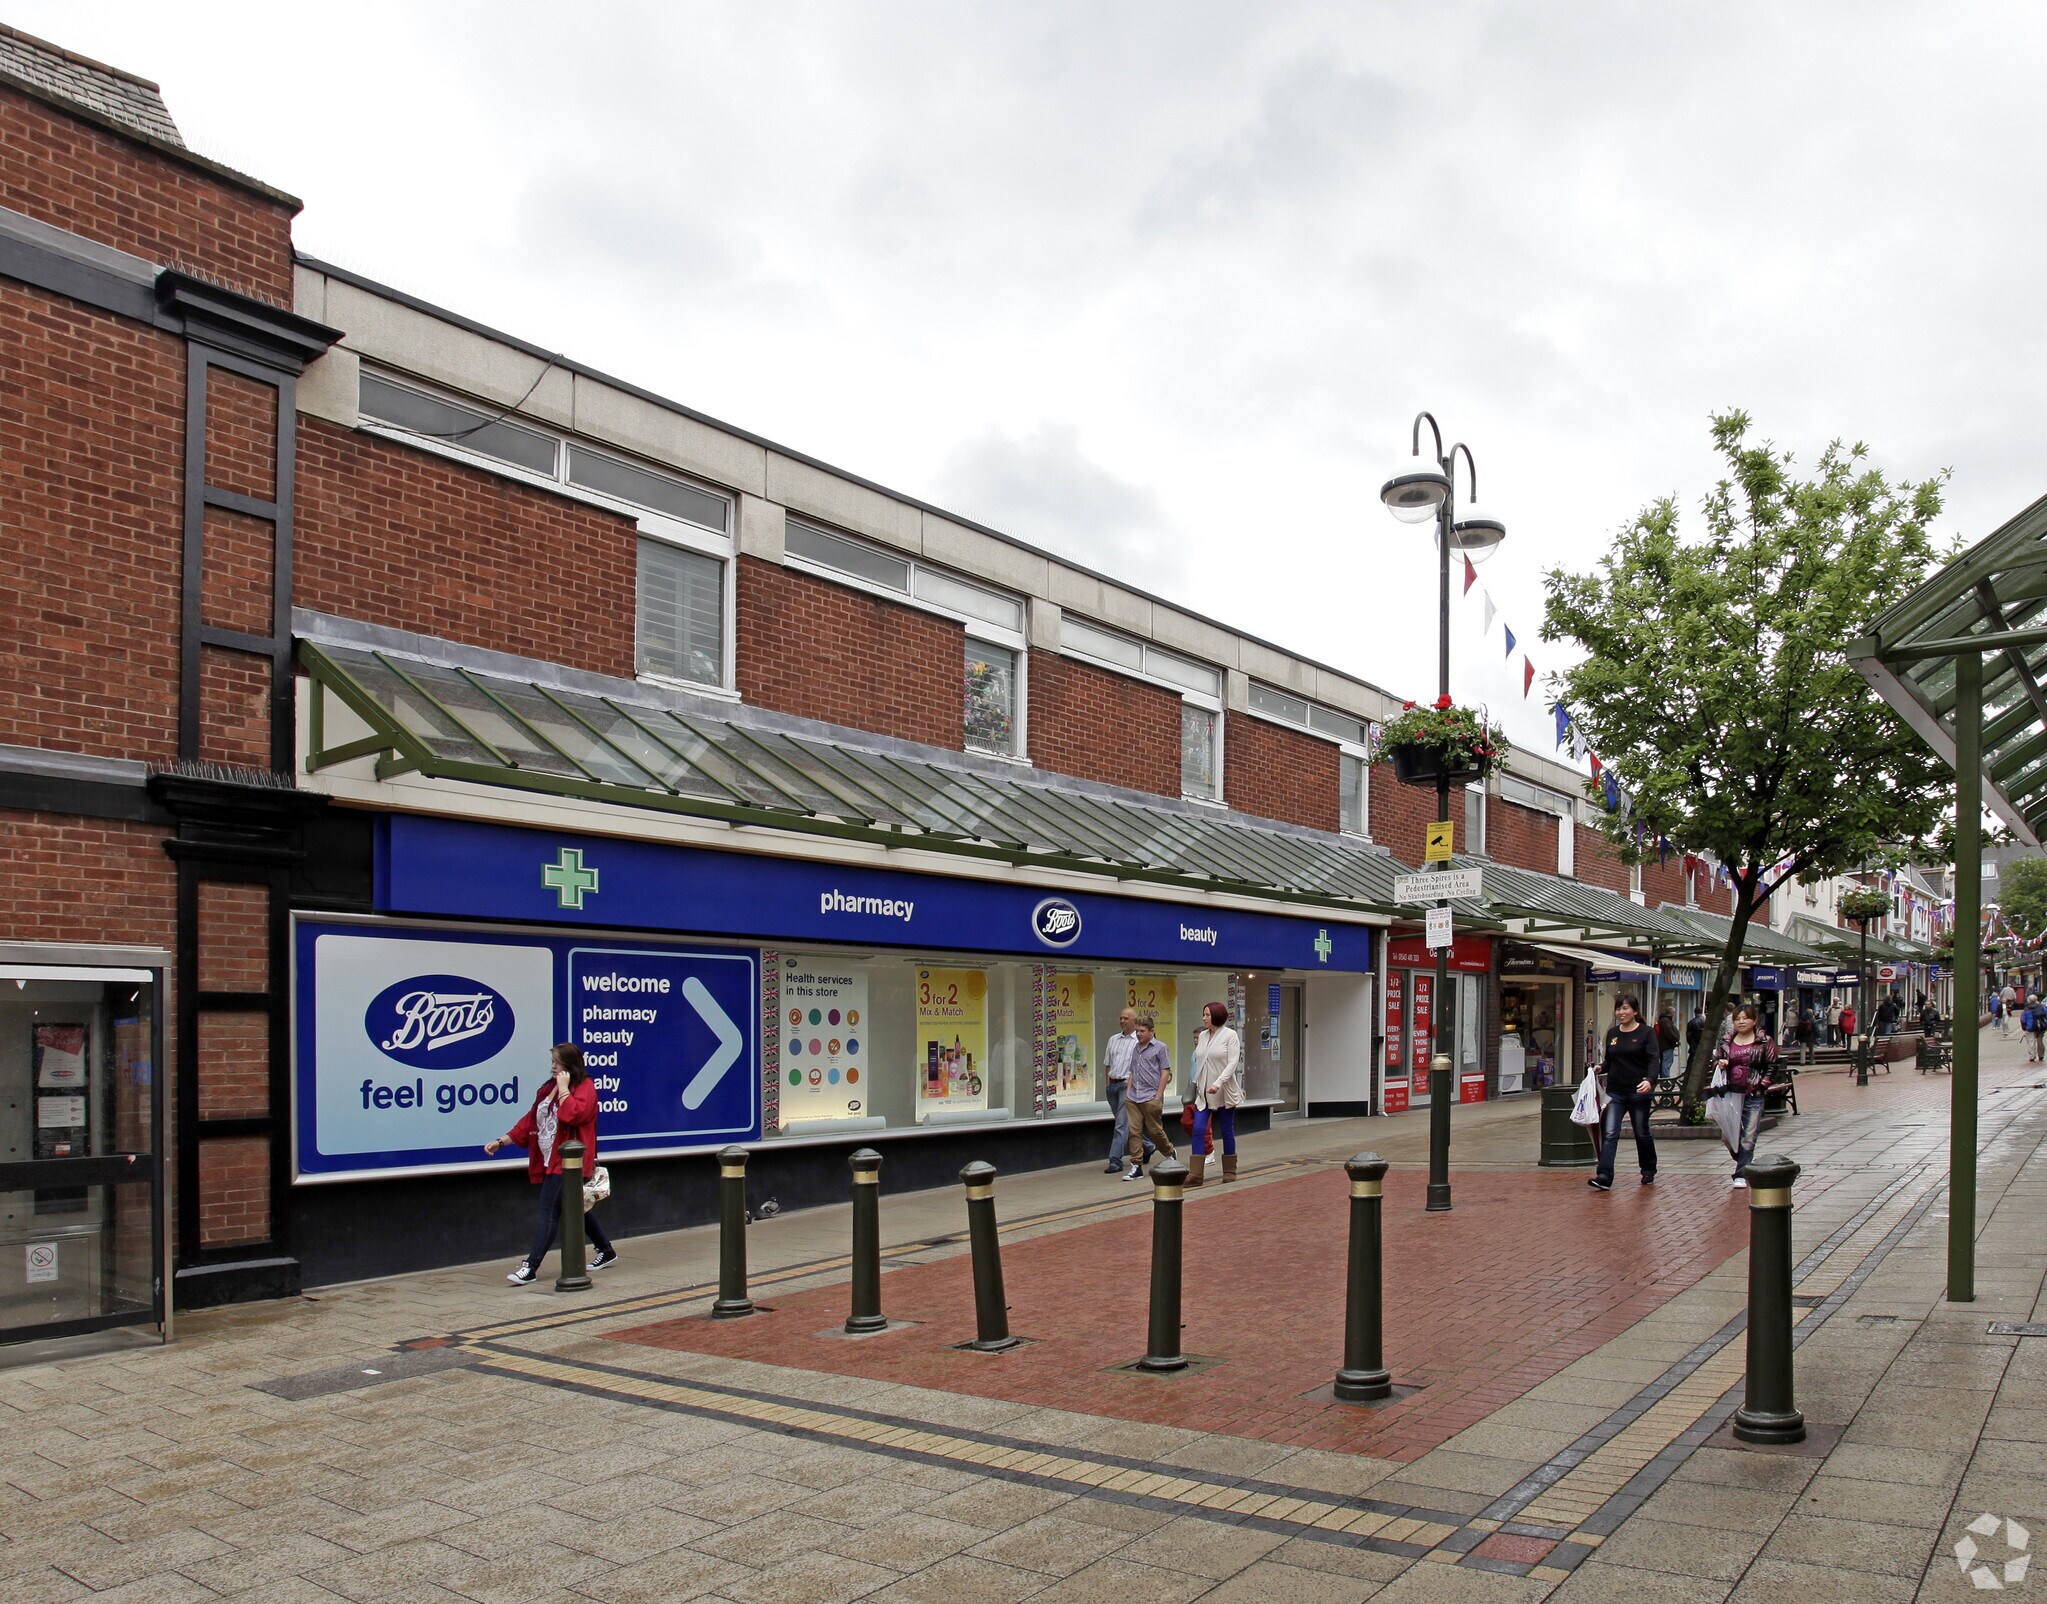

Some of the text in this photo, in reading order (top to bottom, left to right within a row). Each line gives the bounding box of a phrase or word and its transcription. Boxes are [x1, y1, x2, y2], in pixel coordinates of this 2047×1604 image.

[1431, 874, 1451, 882] Spires
[1406, 882, 1452, 892] Pedestrianised
[1408, 891, 1444, 900] Skateboarding
[821, 888, 914, 921] pharmacy
[1042, 908, 1075, 934] Boots
[1180, 923, 1217, 946] beauty
[582, 972, 670, 994] welcome
[786, 973, 853, 985] Health services
[1390, 978, 1399, 987] 1/2
[786, 986, 838, 996] in this store
[920, 983, 958, 1005] 3 for 2
[1387, 990, 1401, 998] PRICE
[1419, 984, 1427, 992] 1/2
[1062, 987, 1070, 1007] 2
[1128, 989, 1155, 1008] 3 for 2
[583, 1005, 657, 1024] pharmacy
[920, 1007, 932, 1016] Mix
[942, 1007, 963, 1016] Match
[1417, 1006, 1428, 1014] SALE
[382, 991, 494, 1051] Boots
[583, 1028, 634, 1046] beauty
[583, 1051, 618, 1066] food
[593, 1074, 620, 1092] aby
[360, 1076, 519, 1113] feel good
[597, 1098, 628, 1112] oto
